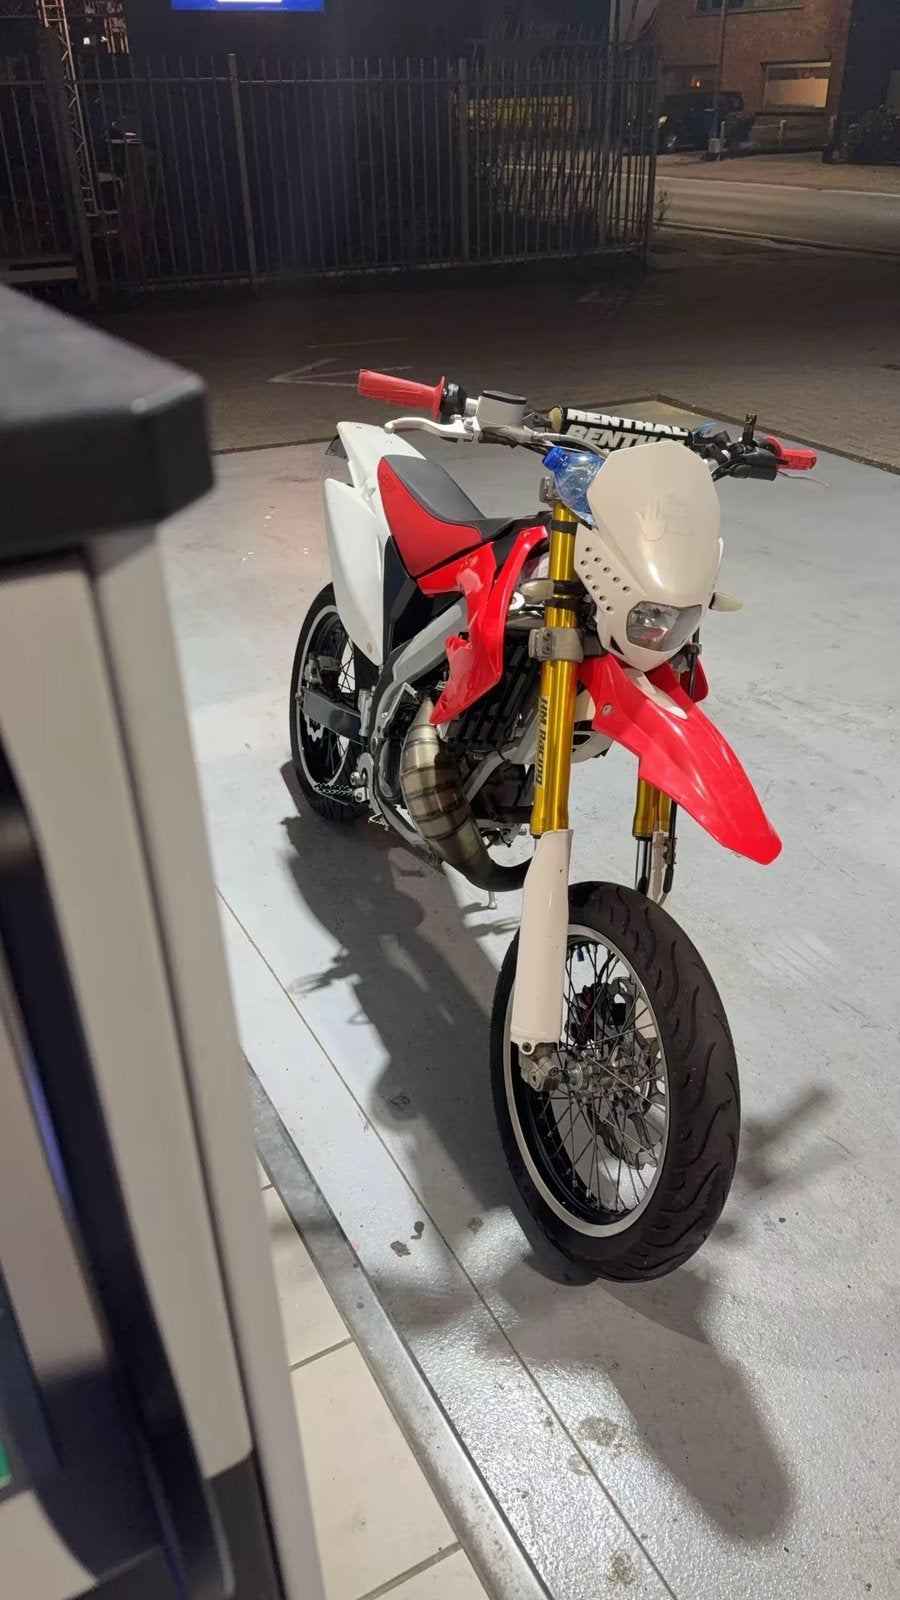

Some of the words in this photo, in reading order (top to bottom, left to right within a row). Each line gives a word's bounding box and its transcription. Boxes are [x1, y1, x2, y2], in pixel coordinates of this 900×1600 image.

[565, 424, 686, 449] RENTH
[540, 698, 549, 725] HM
[535, 729, 546, 786] Racing
